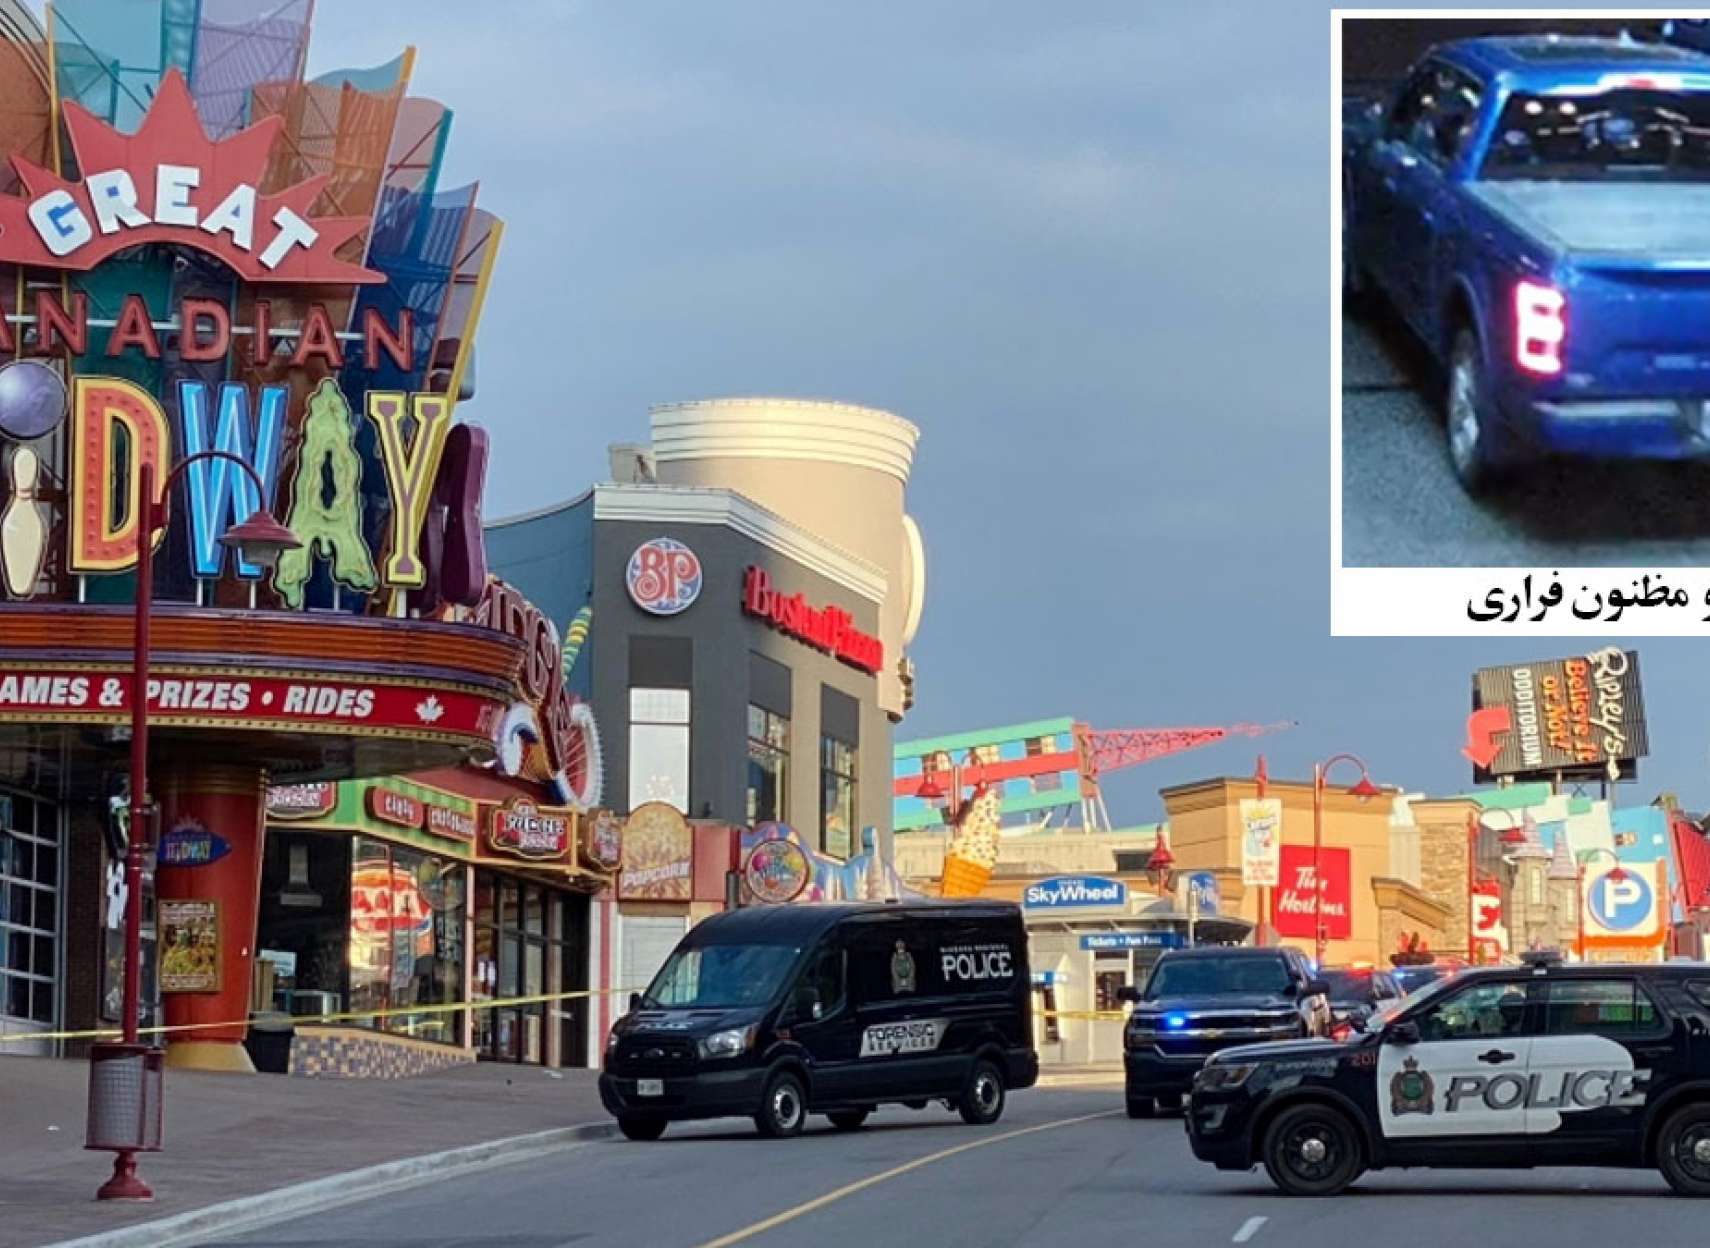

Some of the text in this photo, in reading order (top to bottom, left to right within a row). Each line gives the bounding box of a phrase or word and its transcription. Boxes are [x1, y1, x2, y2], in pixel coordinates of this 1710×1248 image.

[28, 163, 319, 269] GREAT
[633, 543, 697, 602] BP
[99, 677, 125, 707] &
[145, 680, 250, 711] PRIZES
[283, 690, 375, 719] RIDES
[1513, 667, 1543, 766] ODDITORIUM
[1027, 883, 1120, 906] SkyWheel
[1604, 878, 1643, 919] P
[941, 951, 1014, 982] POLICE
[866, 1023, 937, 1041] FORENSIC
[1444, 1069, 1651, 1112] POLICE
